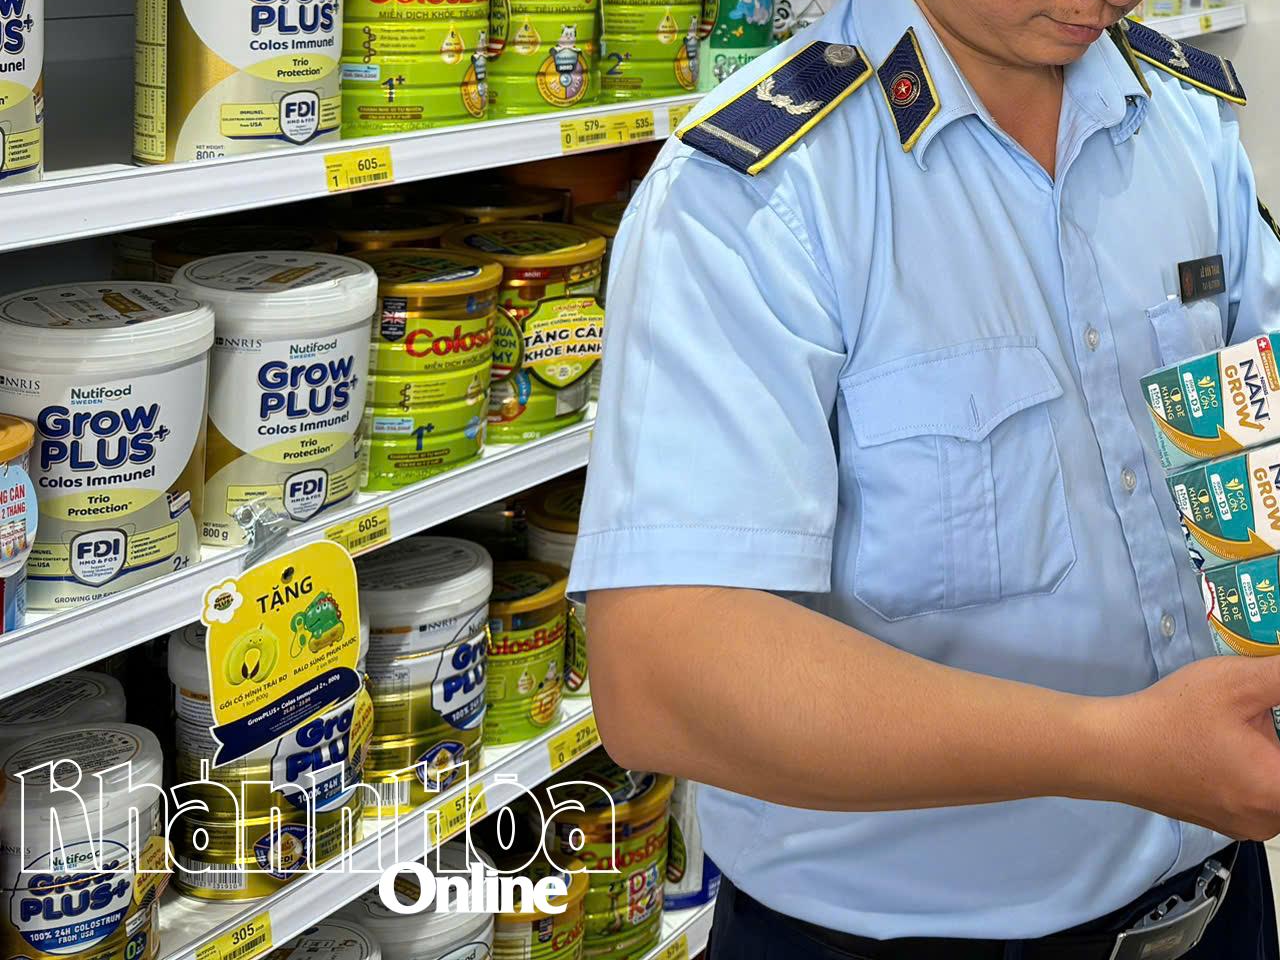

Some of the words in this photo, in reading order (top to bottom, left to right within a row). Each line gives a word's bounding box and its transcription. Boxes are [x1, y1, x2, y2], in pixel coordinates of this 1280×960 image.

[249, 39, 289, 51] Colos
[291, 36, 335, 50] Immunel
[292, 57, 309, 67] Trio
[285, 101, 316, 118] FDI
[250, 120, 263, 128] USA
[584, 120, 600, 132] 579
[635, 117, 650, 129] 535
[357, 157, 378, 171] 605
[289, 340, 338, 355] Nutifood
[524, 343, 563, 363] KHỎE
[258, 355, 355, 390] Grow
[71, 384, 132, 401] Nutifood
[1207, 387, 1219, 408] CAO
[1224, 364, 1265, 432] GROW
[1239, 358, 1271, 421] NAN
[1190, 398, 1201, 414] D3
[37, 402, 161, 440] Grow
[258, 424, 296, 436] Colos
[299, 413, 350, 433] Immunel
[300, 438, 318, 448] Trio
[39, 476, 83, 489] Colos
[87, 466, 156, 487] Immunel
[289, 477, 323, 498] FDI
[87, 494, 111, 506] Trio
[1219, 502, 1229, 515] D3
[1235, 490, 1248, 511] CAO
[358, 516, 378, 533] 605
[202, 528, 219, 539] 800
[77, 538, 121, 559] FDI
[36, 561, 51, 569] USA
[103, 556, 118, 564] FOS
[54, 594, 91, 604] GROWING
[256, 576, 314, 615] TẶNG
[1267, 592, 1278, 614] CAO
[1248, 602, 1259, 618] D3
[20, 878, 131, 923] PLUS+
[74, 912, 121, 933] COLOSTRUM
[80, 929, 95, 939] USA
[232, 922, 255, 945] 305
